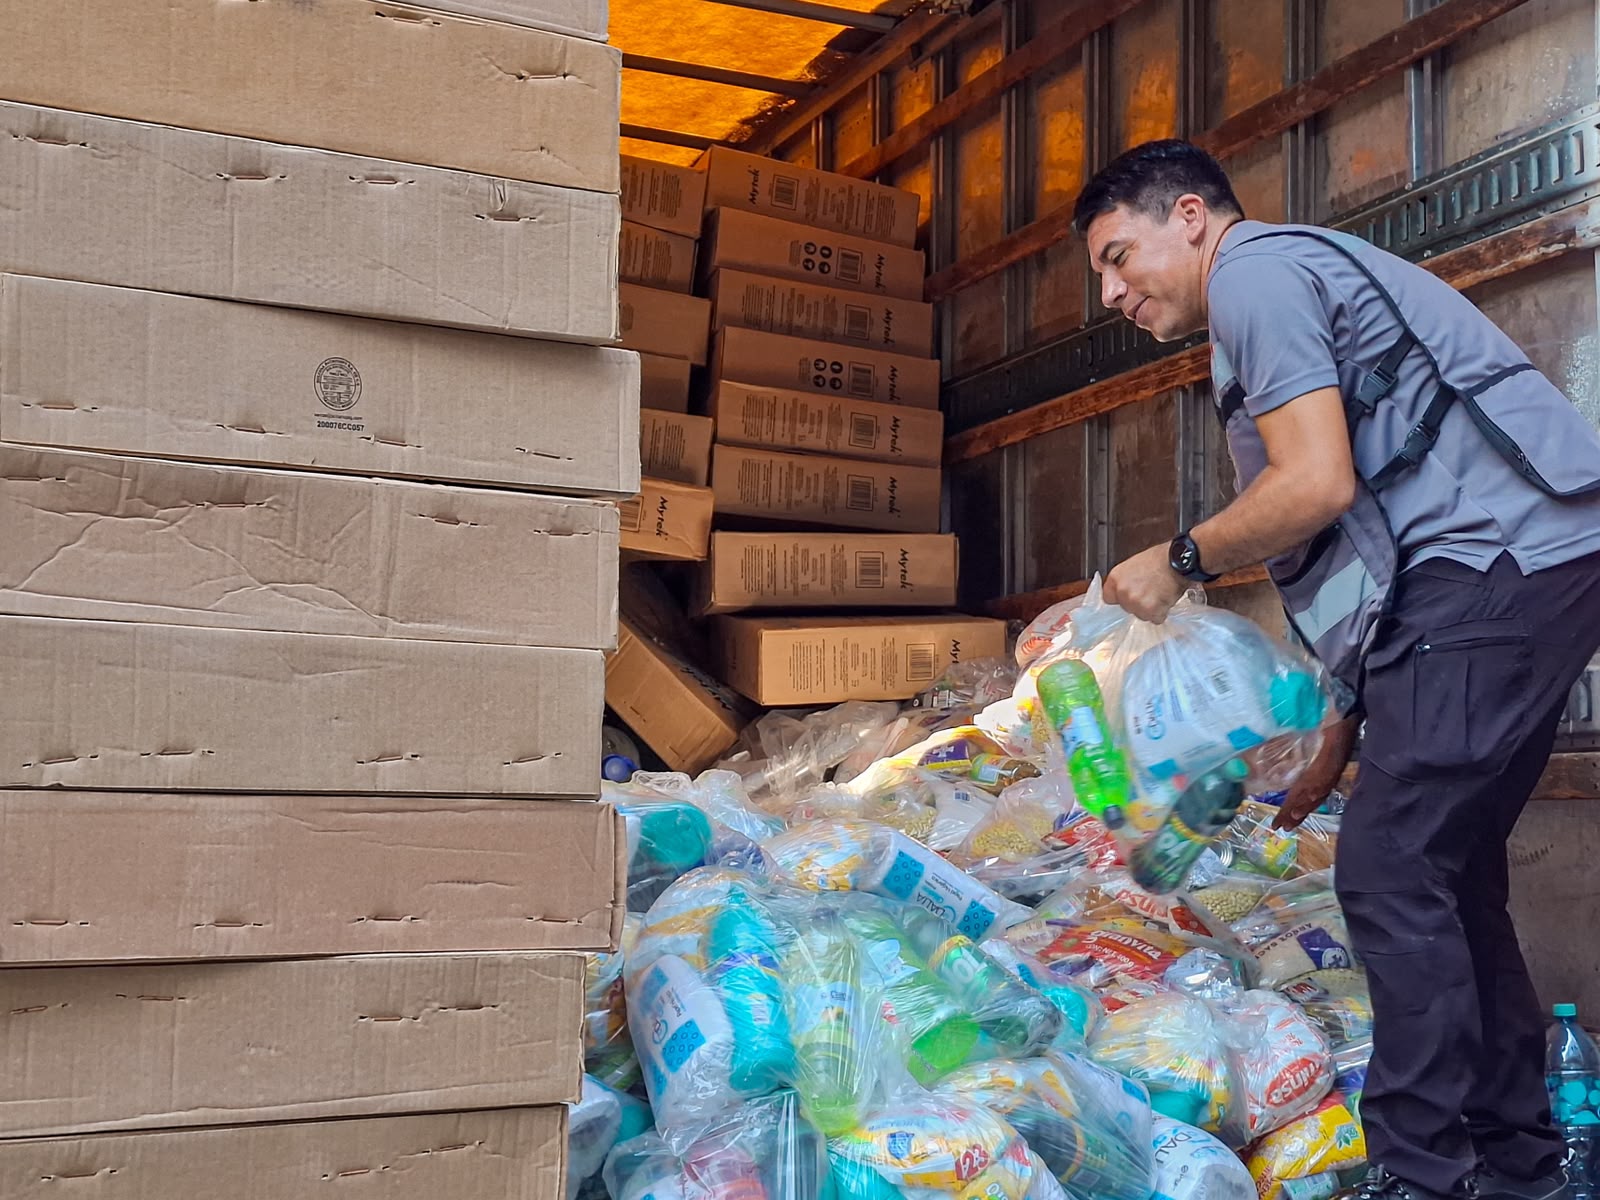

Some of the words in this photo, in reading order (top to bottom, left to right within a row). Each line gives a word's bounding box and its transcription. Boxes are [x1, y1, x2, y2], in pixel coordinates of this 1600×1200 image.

[875, 253, 886, 289] Mytek
[882, 308, 895, 344] Mytek
[888, 365, 901, 401] Mytek
[889, 415, 902, 453] Mytek
[887, 476, 901, 514] Mytek
[656, 495, 669, 537] Mytek
[898, 548, 913, 589] Mytek
[950, 638, 961, 664] Myt
[1081, 930, 1162, 960] granvita
[1154, 1131, 1192, 1165] DALI
